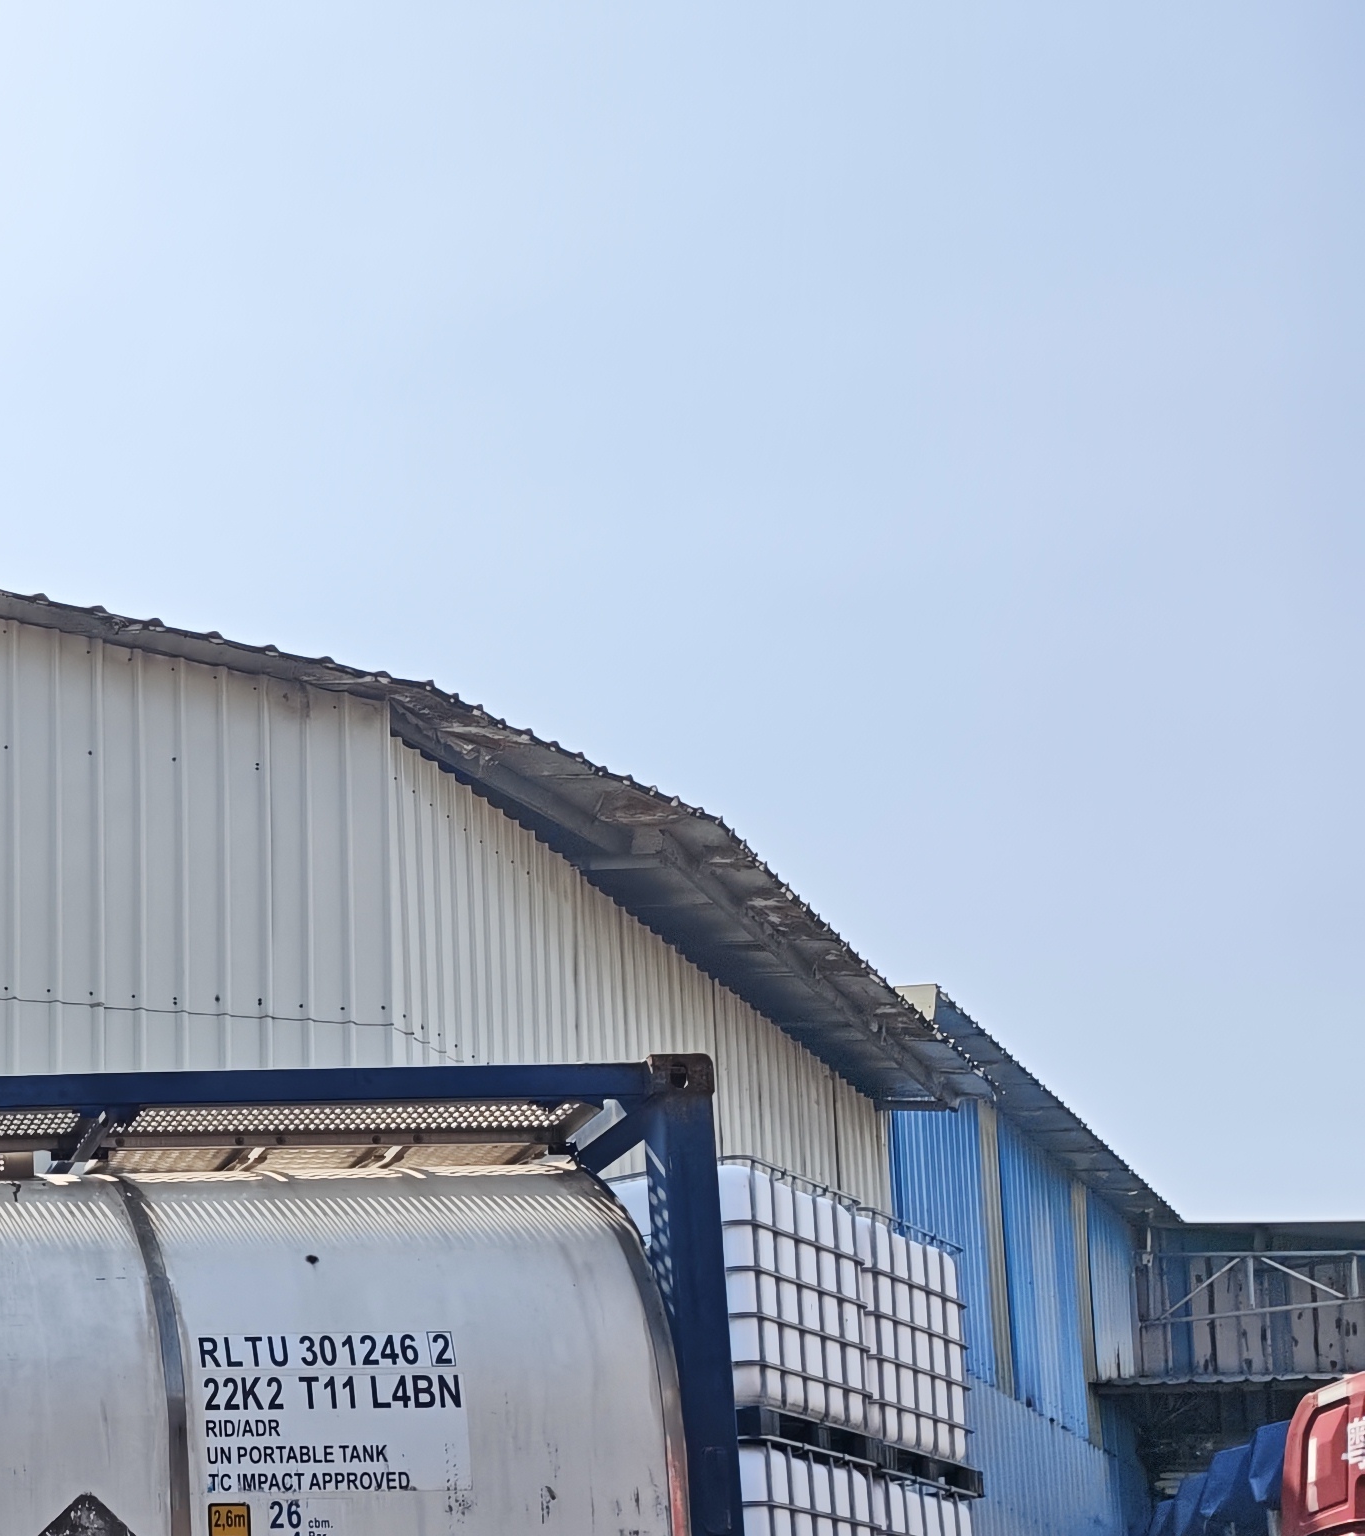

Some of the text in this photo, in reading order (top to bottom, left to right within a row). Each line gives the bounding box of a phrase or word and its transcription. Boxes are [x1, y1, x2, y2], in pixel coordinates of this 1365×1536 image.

[198, 1333, 453, 1368] RLTU 301246 2
[203, 1374, 462, 1411] 22K2 T11 L4BN
[205, 1419, 281, 1438] RID/ADR
[207, 1444, 388, 1464] UN PORTABLE TANK
[209, 1471, 411, 1492] TC IMPACT APPROVED
[213, 1509, 246, 1531] 2,6m
[268, 1500, 334, 1529] 26 cbm.
